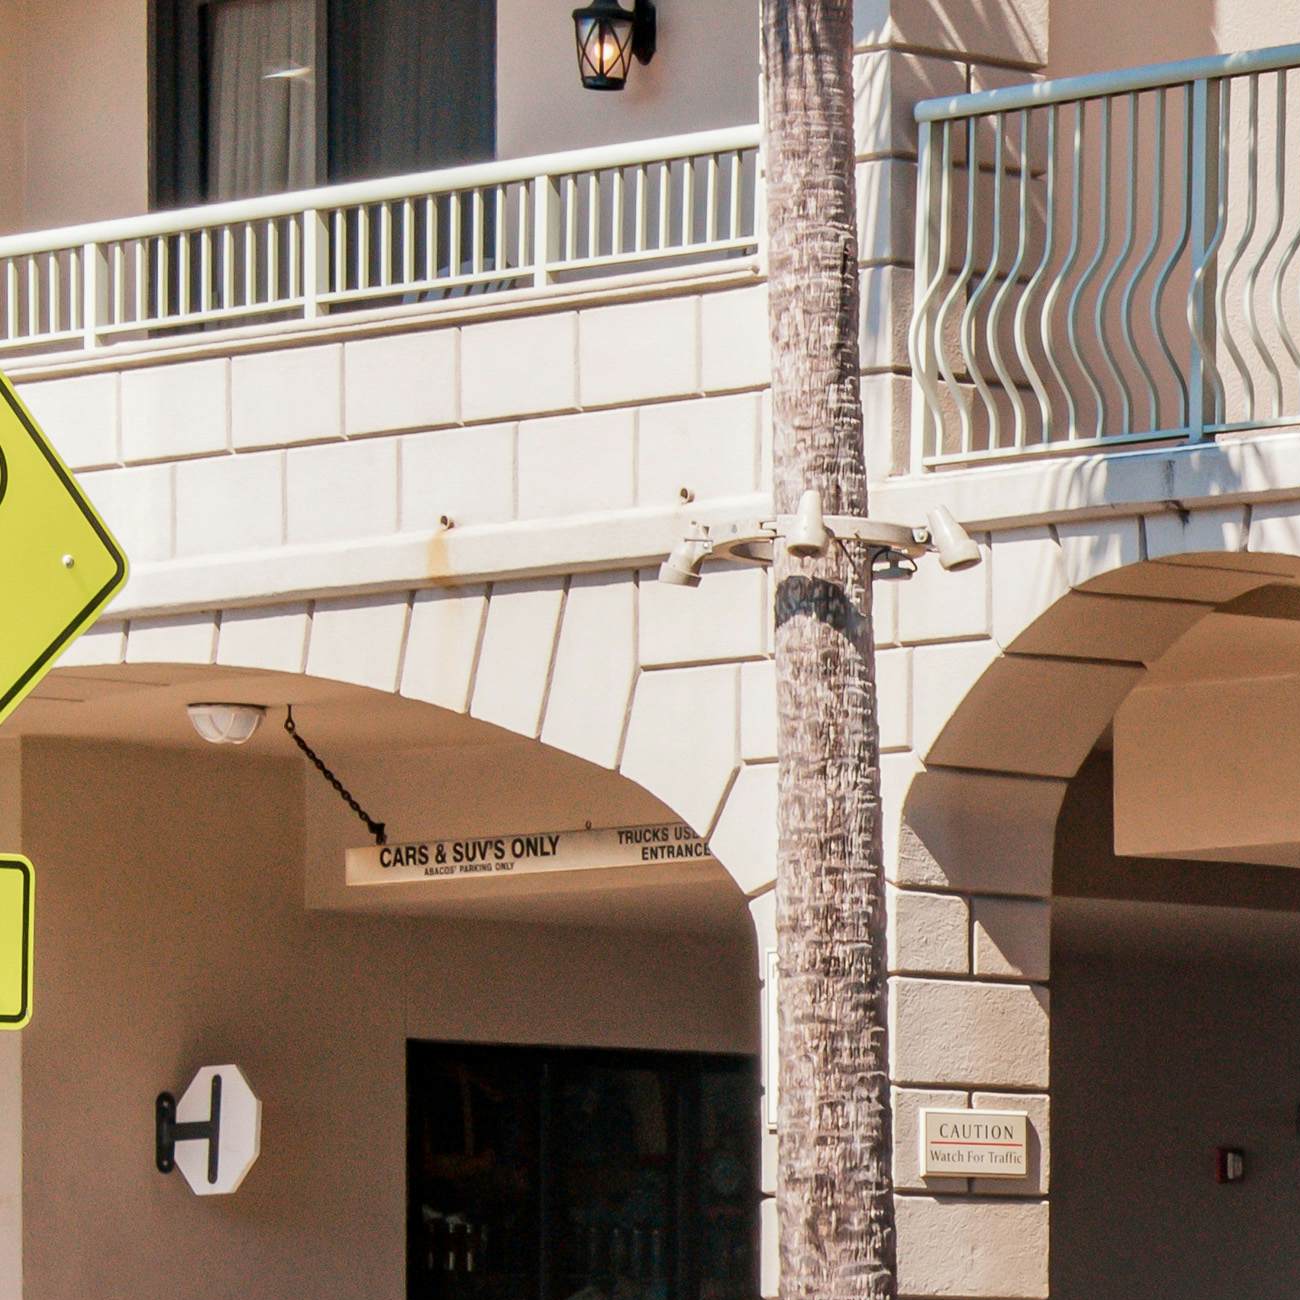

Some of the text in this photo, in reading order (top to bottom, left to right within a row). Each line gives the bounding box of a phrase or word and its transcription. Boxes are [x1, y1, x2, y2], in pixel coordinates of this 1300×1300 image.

[618, 829, 669, 844] TRUCKS
[380, 835, 561, 867] CARS & SUV'S ONLY
[641, 843, 711, 861] ENTRANCE
[460, 863, 493, 873] PARKING
[495, 862, 514, 872] ONLY
[939, 1123, 1014, 1139] CAUTION
[930, 1150, 1022, 1164] Watch For Traffic
